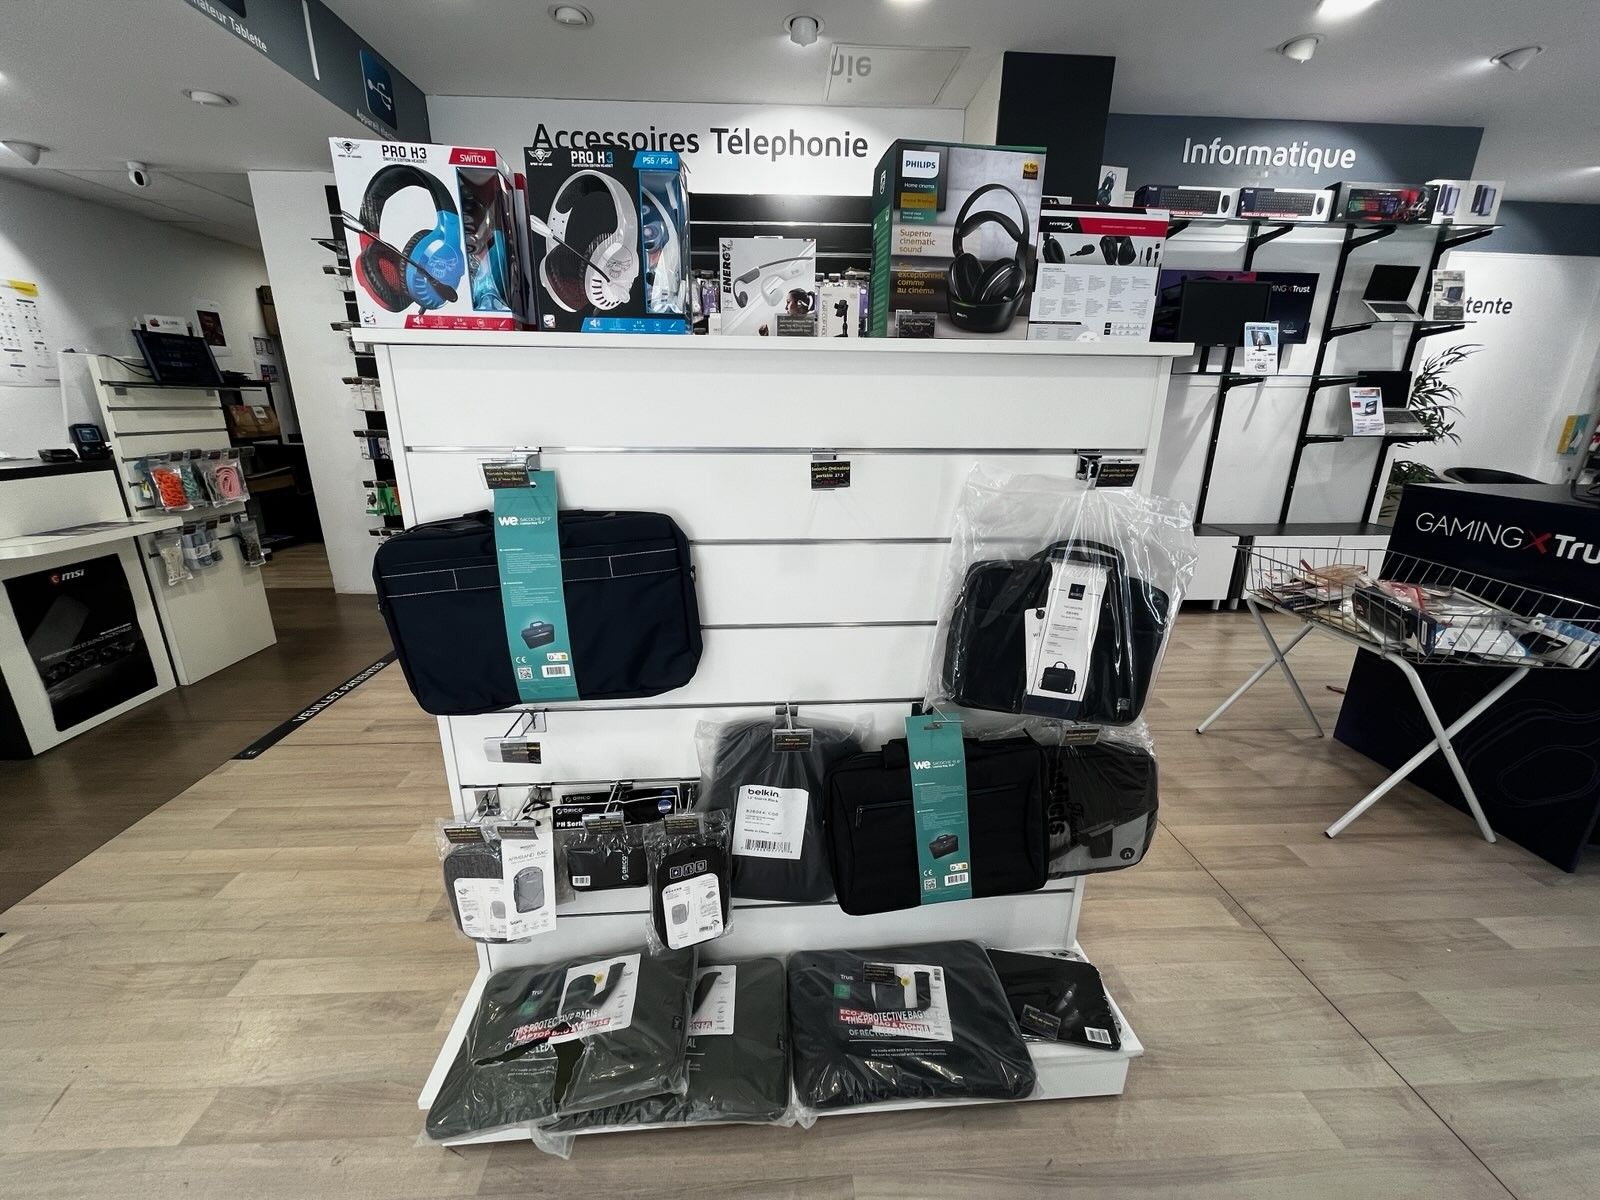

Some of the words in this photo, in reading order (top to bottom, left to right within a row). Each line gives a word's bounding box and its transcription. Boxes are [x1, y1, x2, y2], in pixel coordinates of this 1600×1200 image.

[228, 16, 268, 53] Tablette
[532, 123, 699, 153] Accessoires
[710, 128, 869, 161] Télephonie
[381, 145, 407, 158] PRO
[411, 147, 427, 159] H3
[571, 151, 594, 163] PRO
[597, 151, 614, 163] H3
[1182, 137, 1357, 174] Informatique
[459, 155, 487, 164] SWITCH
[643, 157, 655, 165] PS5
[905, 160, 936, 169] PHILIPS
[900, 229, 932, 239] Superior
[899, 238, 936, 246] cinematic
[722, 244, 732, 293] ENERGY
[1293, 285, 1311, 293] Trust
[1465, 297, 1513, 315] tente
[498, 516, 519, 526] we
[1415, 512, 1525, 549] GAMING
[1552, 534, 1600, 565] Tru
[61, 568, 85, 582] msi
[292, 689, 345, 722] VEUILLEZ
[339, 661, 388, 692] PATIENTER
[913, 760, 931, 770] we
[747, 788, 779, 798] belkin
[863, 1011, 908, 1022] PROTECTIVE
[908, 1010, 923, 1020] BAG
